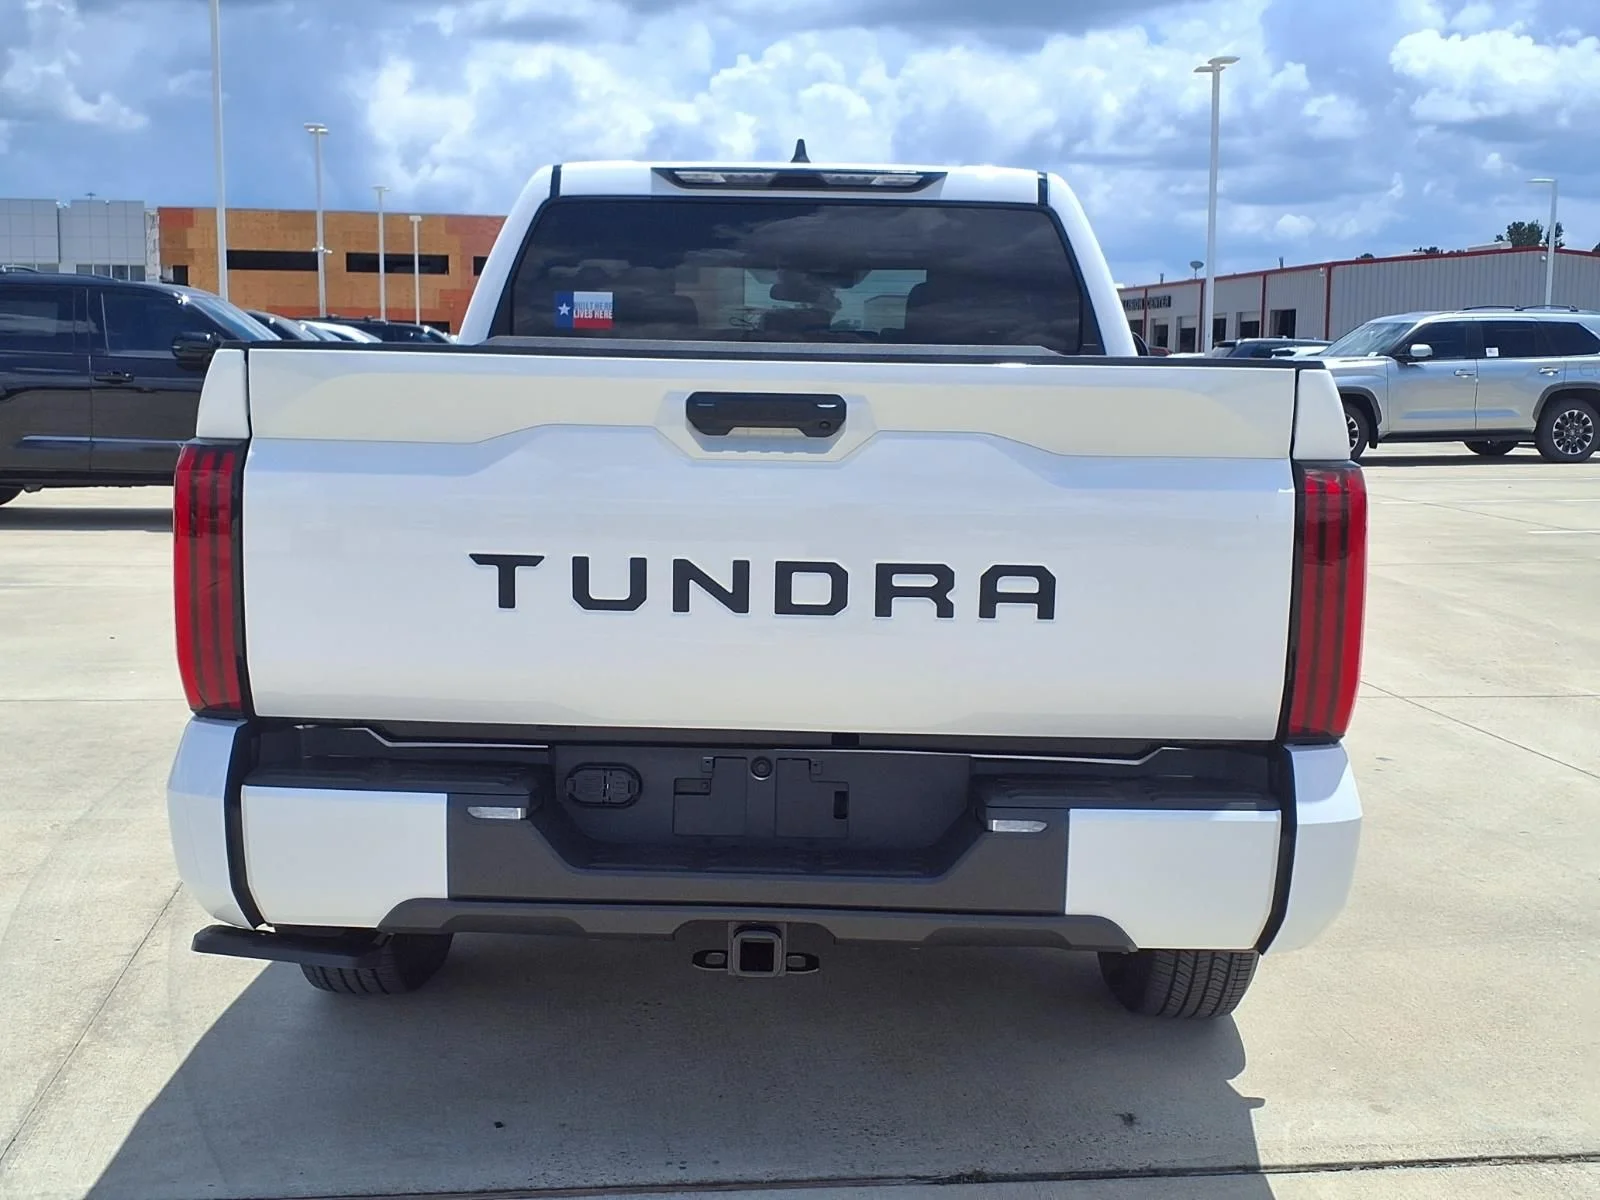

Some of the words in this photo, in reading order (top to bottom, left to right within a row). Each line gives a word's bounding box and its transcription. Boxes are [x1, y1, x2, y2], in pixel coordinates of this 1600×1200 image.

[573, 309, 593, 319] LIVES
[594, 310, 613, 320] HERE
[469, 553, 1056, 620] TUNDRA
